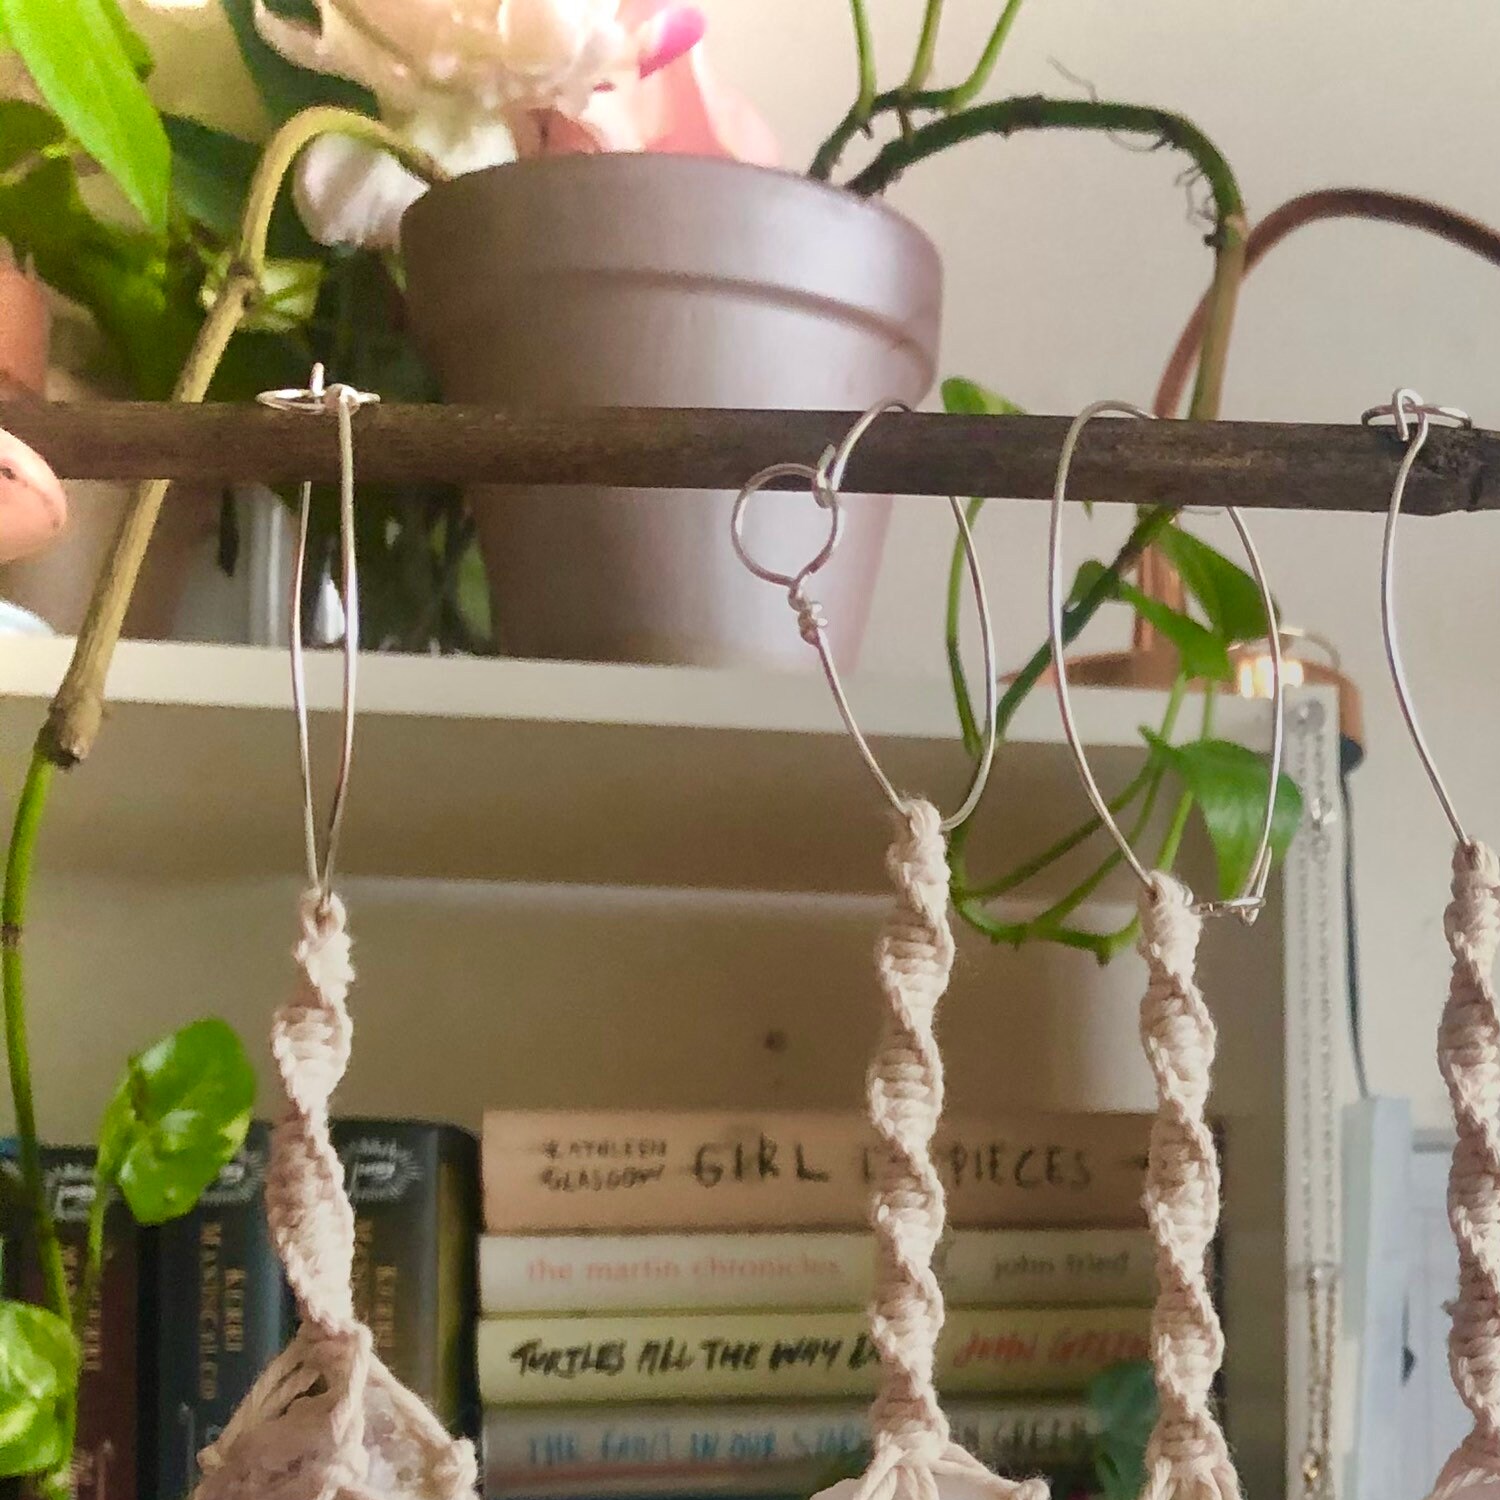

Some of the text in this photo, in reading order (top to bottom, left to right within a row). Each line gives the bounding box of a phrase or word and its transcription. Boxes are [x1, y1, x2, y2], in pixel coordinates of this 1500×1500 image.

[694, 1131, 830, 1189] GIRL
[950, 1142, 1092, 1190] PIECES
[510, 1336, 628, 1379] TURTLES
[637, 1335, 697, 1375] ALL
[701, 1335, 759, 1372] THE
[768, 1335, 844, 1374] WAY
